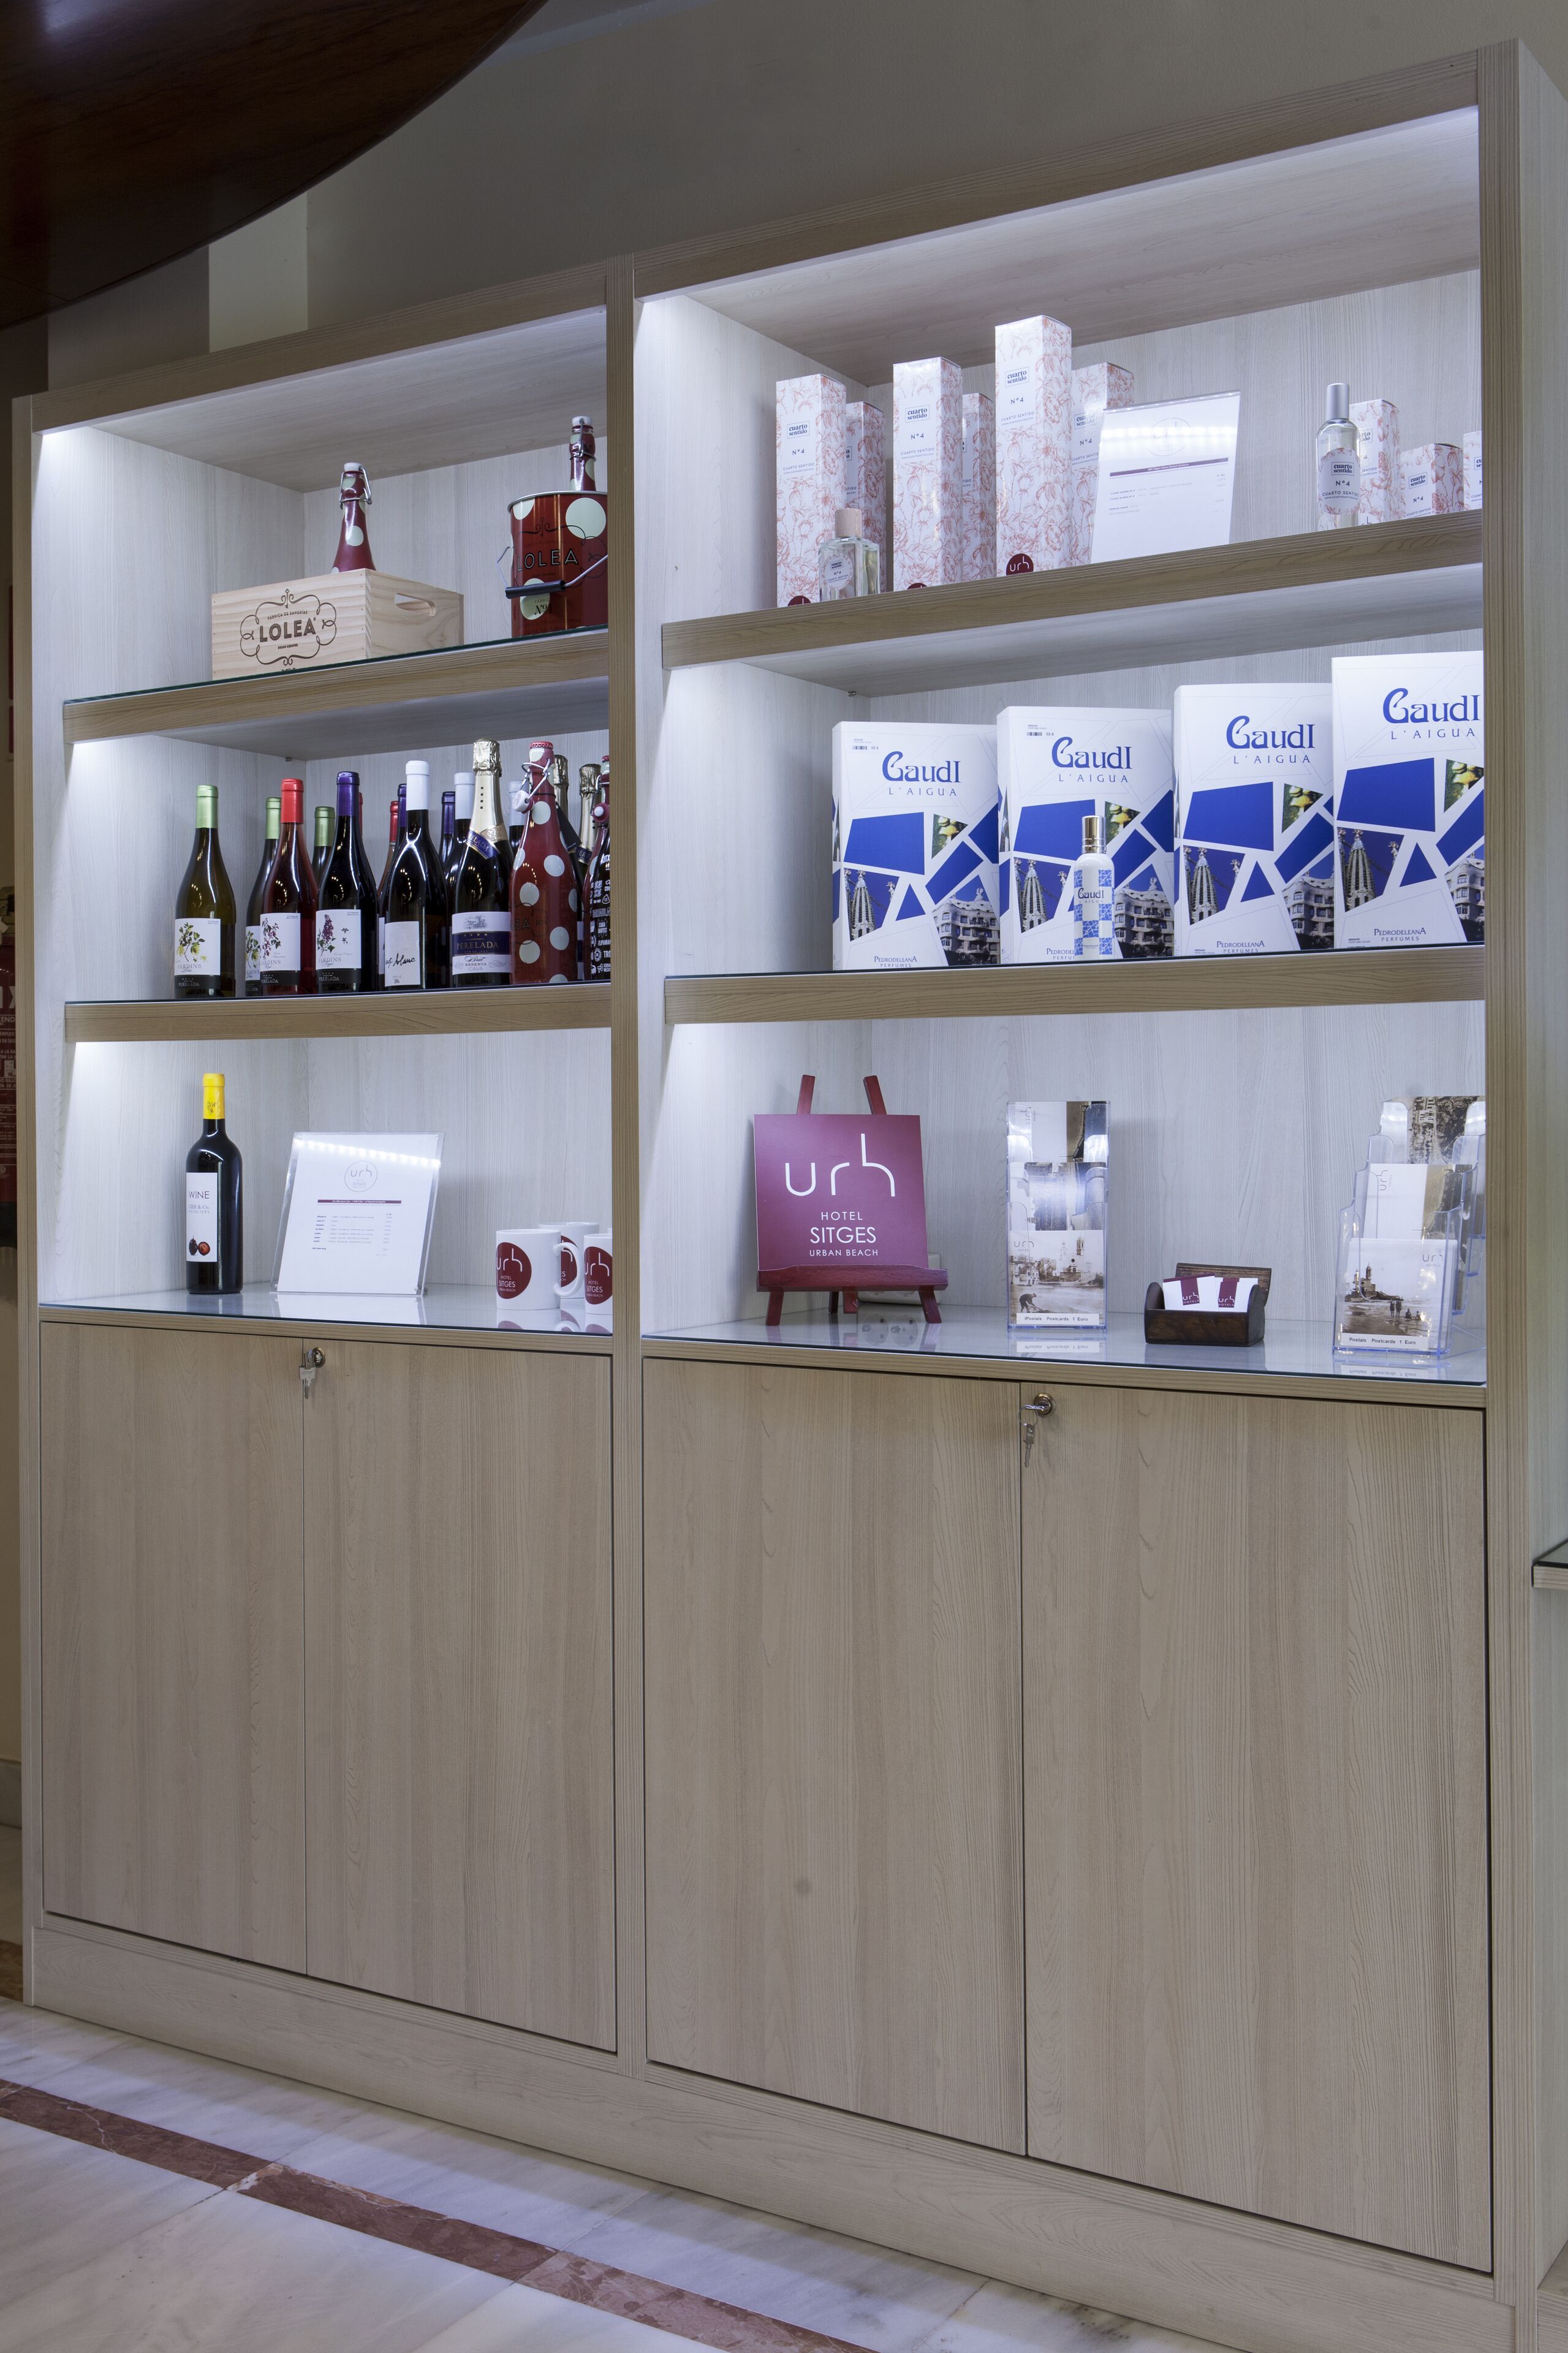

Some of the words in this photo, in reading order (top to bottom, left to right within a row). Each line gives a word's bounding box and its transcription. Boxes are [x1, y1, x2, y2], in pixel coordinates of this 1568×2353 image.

[1007, 370, 1027, 379] cuarto
[517, 550, 578, 572] LOLEA
[1010, 556, 1029, 572] urh
[259, 618, 316, 643] LOLEA
[1391, 728, 1475, 740] L'AIGUA
[1233, 754, 1311, 764] L'AIGUA
[1059, 774, 1128, 783] L'AIGUA
[889, 787, 957, 797] L'AIGUA
[456, 941, 499, 950] PERELADA
[785, 1133, 896, 1197] urh
[189, 1191, 210, 1199] WINE
[821, 1211, 863, 1221] HOTEL
[810, 1226, 877, 1244] SITGES
[1183, 1292, 1199, 1300] urh
